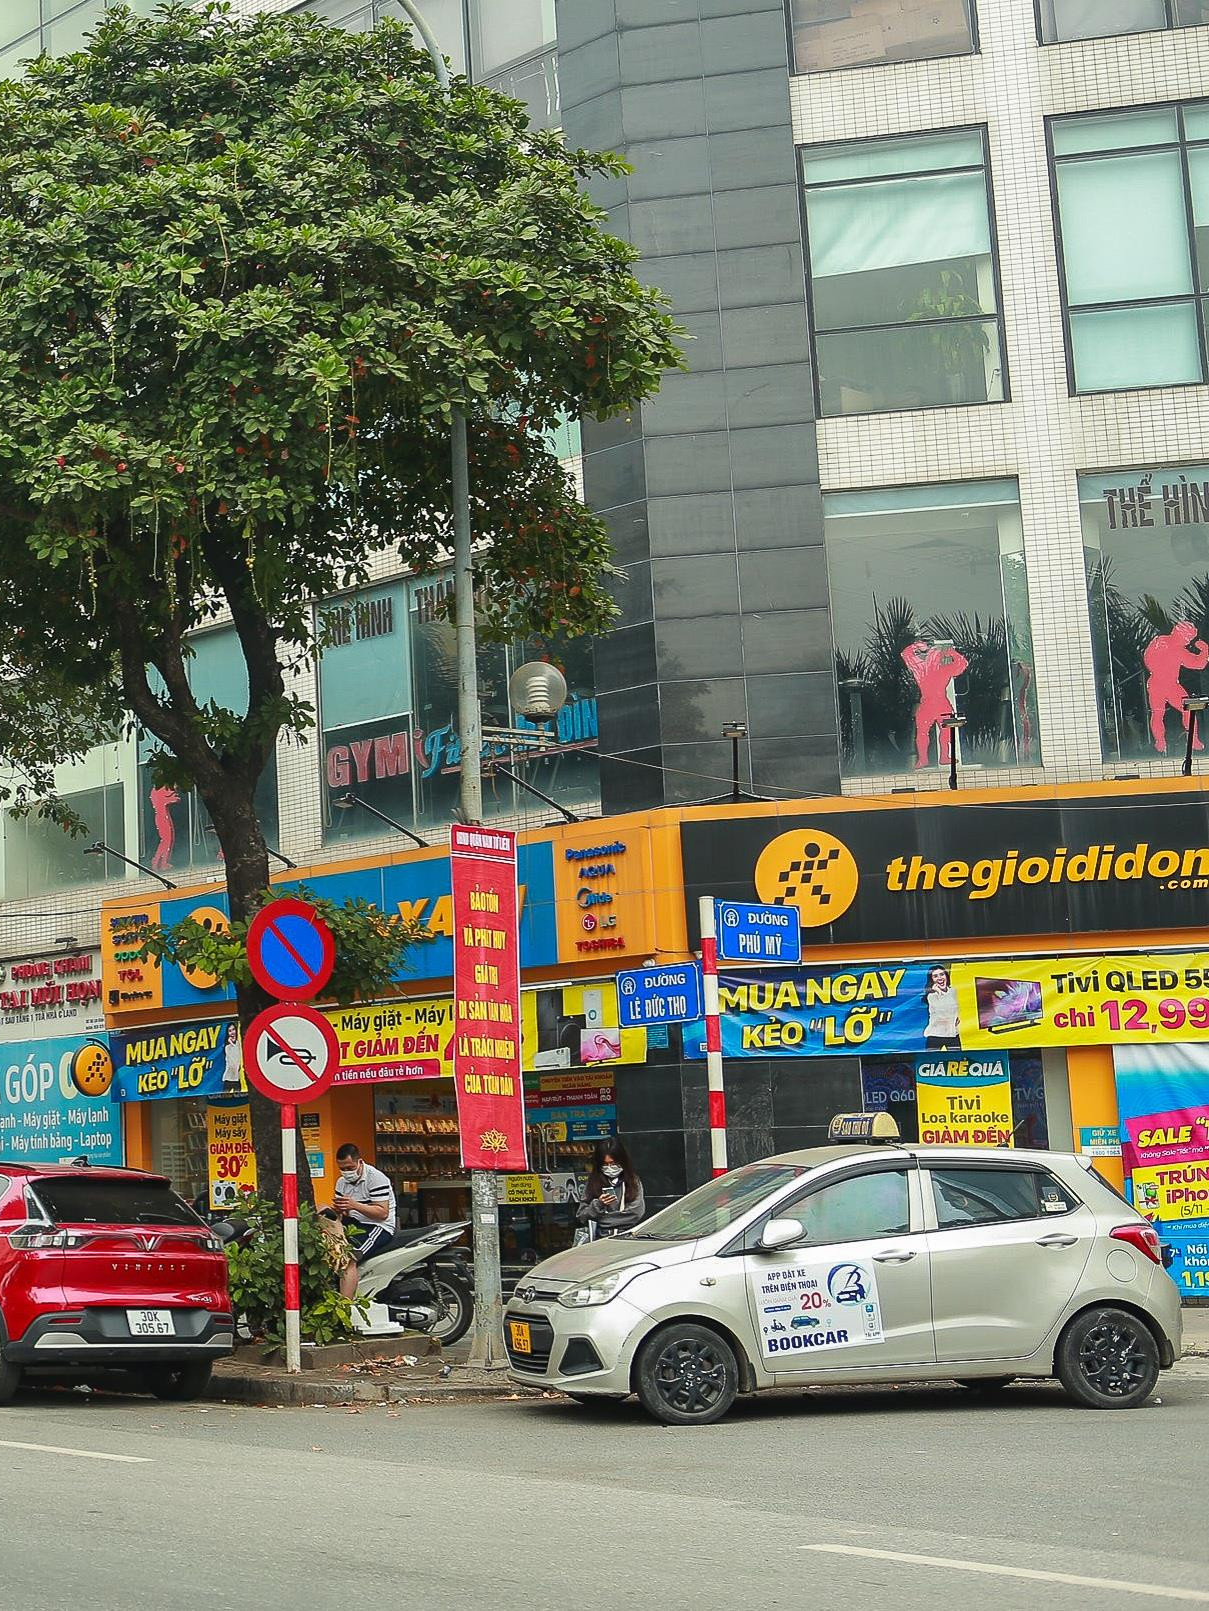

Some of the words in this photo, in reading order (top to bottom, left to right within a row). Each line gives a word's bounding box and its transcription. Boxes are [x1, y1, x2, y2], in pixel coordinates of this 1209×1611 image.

[1103, 473, 1154, 529] THỂ
[1162, 474, 1209, 526] HÌN
[327, 731, 410, 788] GYM
[565, 841, 627, 860] Panasonic
[578, 864, 616, 879] AQUA
[886, 843, 1209, 900] thegioididon
[470, 884, 485, 911] BẢO
[600, 913, 616, 928] LG
[748, 912, 789, 926] ĐƯỜNG
[463, 924, 473, 947] VÀ
[493, 930, 506, 950] HUY
[739, 931, 761, 954] PHÚ
[765, 934, 782, 956] MỸ
[11, 959, 51, 981] PHÒNG
[54, 954, 92, 975] KHÁM
[474, 961, 488, 984] GIÁ
[644, 973, 686, 988] ĐƯỜNG
[718, 980, 801, 1013] MUA
[806, 968, 906, 1006] NGAY
[1051, 969, 1099, 993] Tivi
[1106, 970, 1179, 992] QLED
[0, 990, 29, 1011] TAI
[31, 981, 62, 1006] MŨI
[66, 979, 101, 1006] HỌN
[459, 1000, 467, 1020] DI
[469, 993, 487, 1021] SẢN
[630, 996, 641, 1020] LÊ
[645, 994, 666, 1018] ĐỨC
[667, 995, 687, 1018] THỌ
[1054, 1005, 1095, 1028] chỉ
[1101, 997, 1209, 1034] 12,99
[342, 1014, 369, 1033] Máy
[374, 1010, 402, 1031] giặt
[415, 1004, 447, 1028] Máy
[354, 1031, 399, 1059] GIẢM
[403, 1026, 440, 1055] ĐẾN
[743, 1016, 803, 1049] KẺO
[125, 1036, 167, 1066] MUA
[170, 1025, 221, 1057] NGAY
[459, 1033, 469, 1057] LÀ
[341, 1067, 359, 1081] tiền
[360, 1065, 377, 1079] nếu
[378, 1065, 394, 1077] đâu
[405, 1065, 423, 1076] hơn
[918, 1061, 946, 1077] GIÁ
[947, 1057, 968, 1077] RẺ
[969, 1061, 1004, 1076] QUÁ
[6, 1053, 54, 1104] GÓP
[138, 1066, 168, 1094] KẺO
[464, 1066, 481, 1094] CỦA
[946, 1095, 981, 1110] Tivi
[23, 1111, 41, 1130] Máy
[43, 1110, 60, 1130] giặt
[68, 1107, 86, 1128] Máy
[88, 1106, 108, 1127] lạnh
[214, 1113, 230, 1126] Máy
[232, 1112, 248, 1126] giặt
[922, 1112, 946, 1123] Loa
[950, 1112, 1009, 1123] karaoke
[11, 1135, 29, 1153] Máy
[30, 1134, 49, 1150] tính
[50, 1132, 72, 1151] bảng
[80, 1132, 112, 1149] Laptop
[215, 1127, 230, 1140] Máy
[233, 1124, 247, 1140] sấy
[922, 1125, 969, 1144] GIẢM
[972, 1124, 1010, 1144] ĐẾN
[1137, 1126, 1193, 1148] SALE
[210, 1139, 234, 1155] GIẢM
[235, 1138, 255, 1154] ĐẾN
[1140, 1151, 1162, 1159] Không
[1162, 1149, 1176, 1157] Sale
[217, 1155, 248, 1179] 30%
[1156, 1165, 1209, 1186] TRÚN
[1166, 1188, 1209, 1204] iPho
[112, 1263, 186, 1271] VINFAST
[1184, 1256, 1209, 1267] khô
[767, 1271, 781, 1281] APP
[797, 1269, 806, 1277] XE
[761, 1282, 779, 1294] TRÊN
[798, 1279, 817, 1291] THOẠI
[800, 1291, 831, 1310] 20%
[140, 1311, 160, 1322] 30K
[135, 1322, 169, 1334] 305.67
[767, 1329, 849, 1353] BOOKCAR
